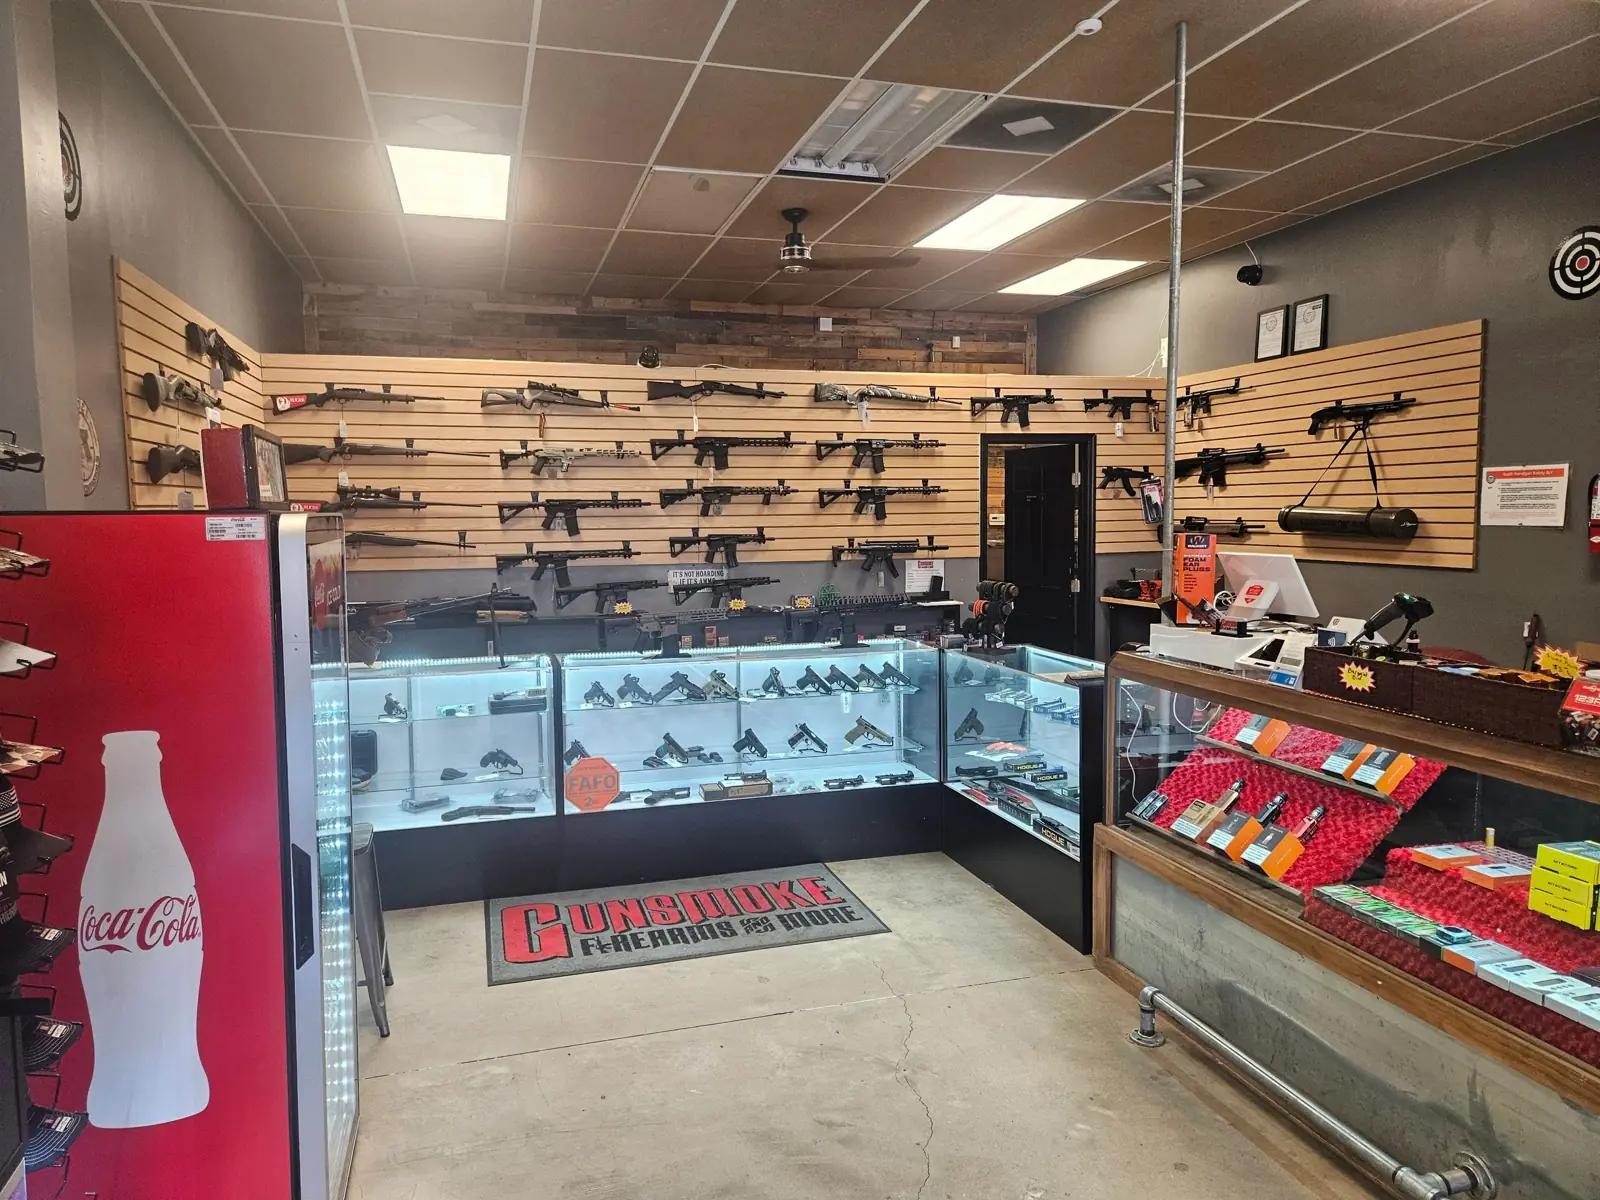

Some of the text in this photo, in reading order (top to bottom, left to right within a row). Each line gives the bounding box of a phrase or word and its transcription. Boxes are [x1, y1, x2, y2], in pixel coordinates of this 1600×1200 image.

[569, 774, 617, 792] FAFO
[1041, 827, 1065, 846] HOGUE
[80, 894, 202, 955] Coca-Cola
[501, 876, 848, 963] GUNSMOKE
[775, 906, 864, 932] MORE
